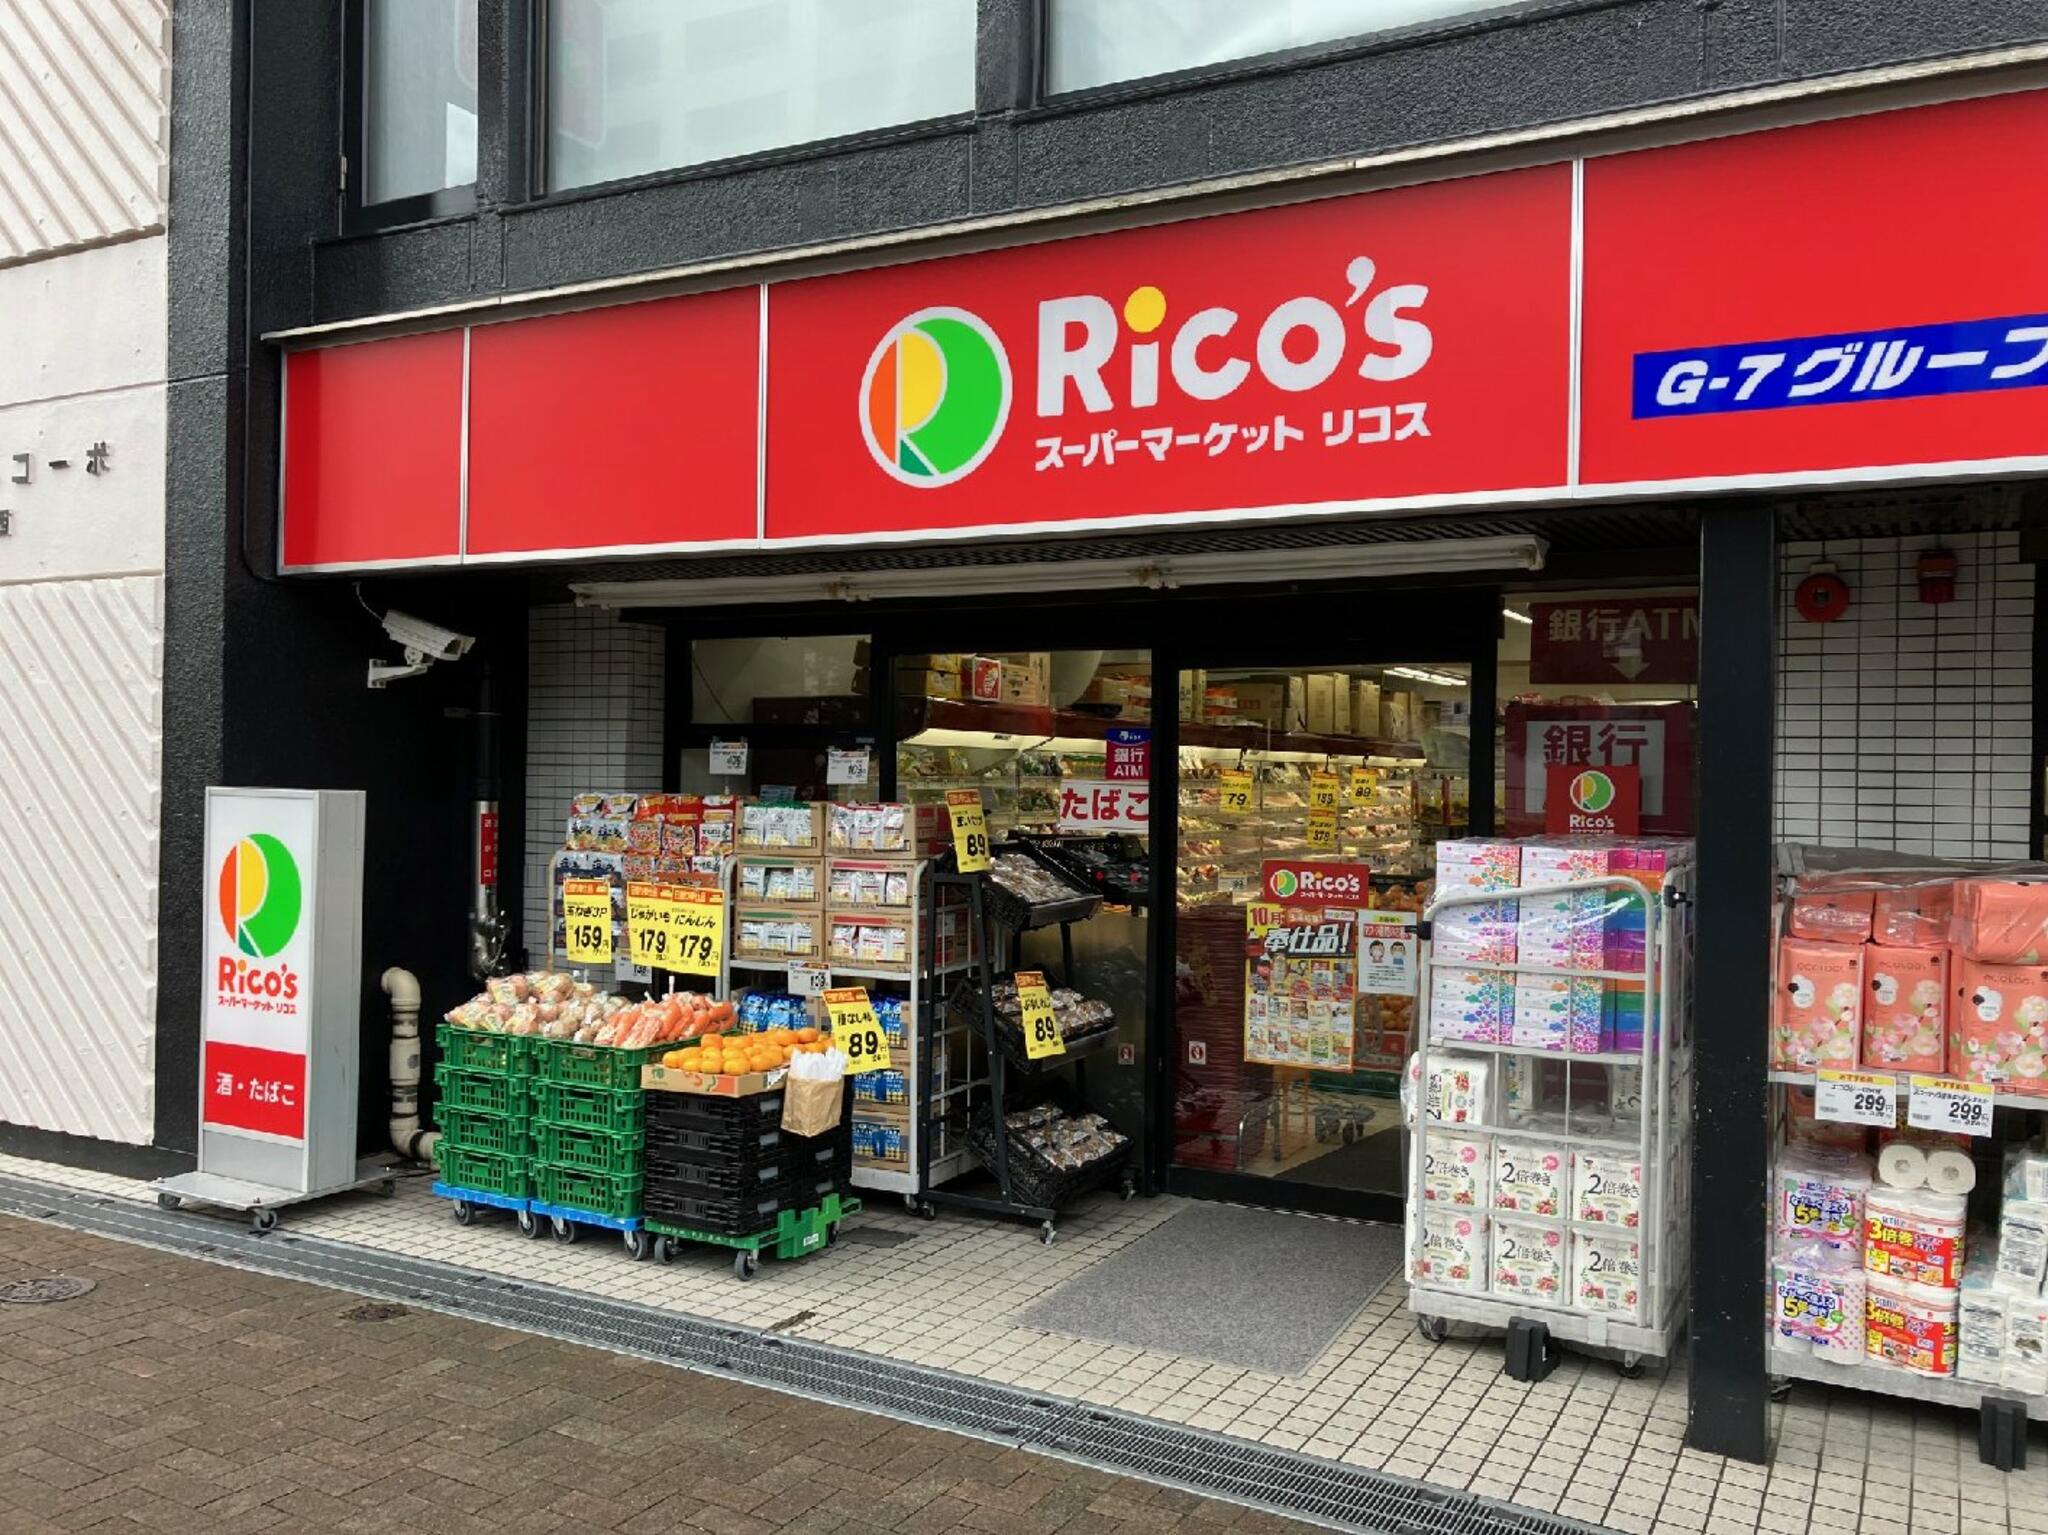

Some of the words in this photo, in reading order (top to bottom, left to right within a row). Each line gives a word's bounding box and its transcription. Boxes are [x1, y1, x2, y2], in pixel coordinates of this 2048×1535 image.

[1036, 255, 1433, 417] Rico's
[1035, 414, 1304, 471] スーパーマーケット
[1322, 402, 1431, 446] リコス
[1113, 747, 1145, 763] 銀行
[1113, 764, 1144, 777] ATM
[1061, 787, 1149, 822] たばこ
[1227, 793, 1247, 806] 79
[1569, 814, 1615, 828] Rico's
[966, 833, 986, 856] 89
[1300, 871, 1361, 892] Rico's
[674, 914, 717, 929] にんじん
[217, 955, 298, 999] Rico's
[1035, 1016, 1056, 1042] 89
